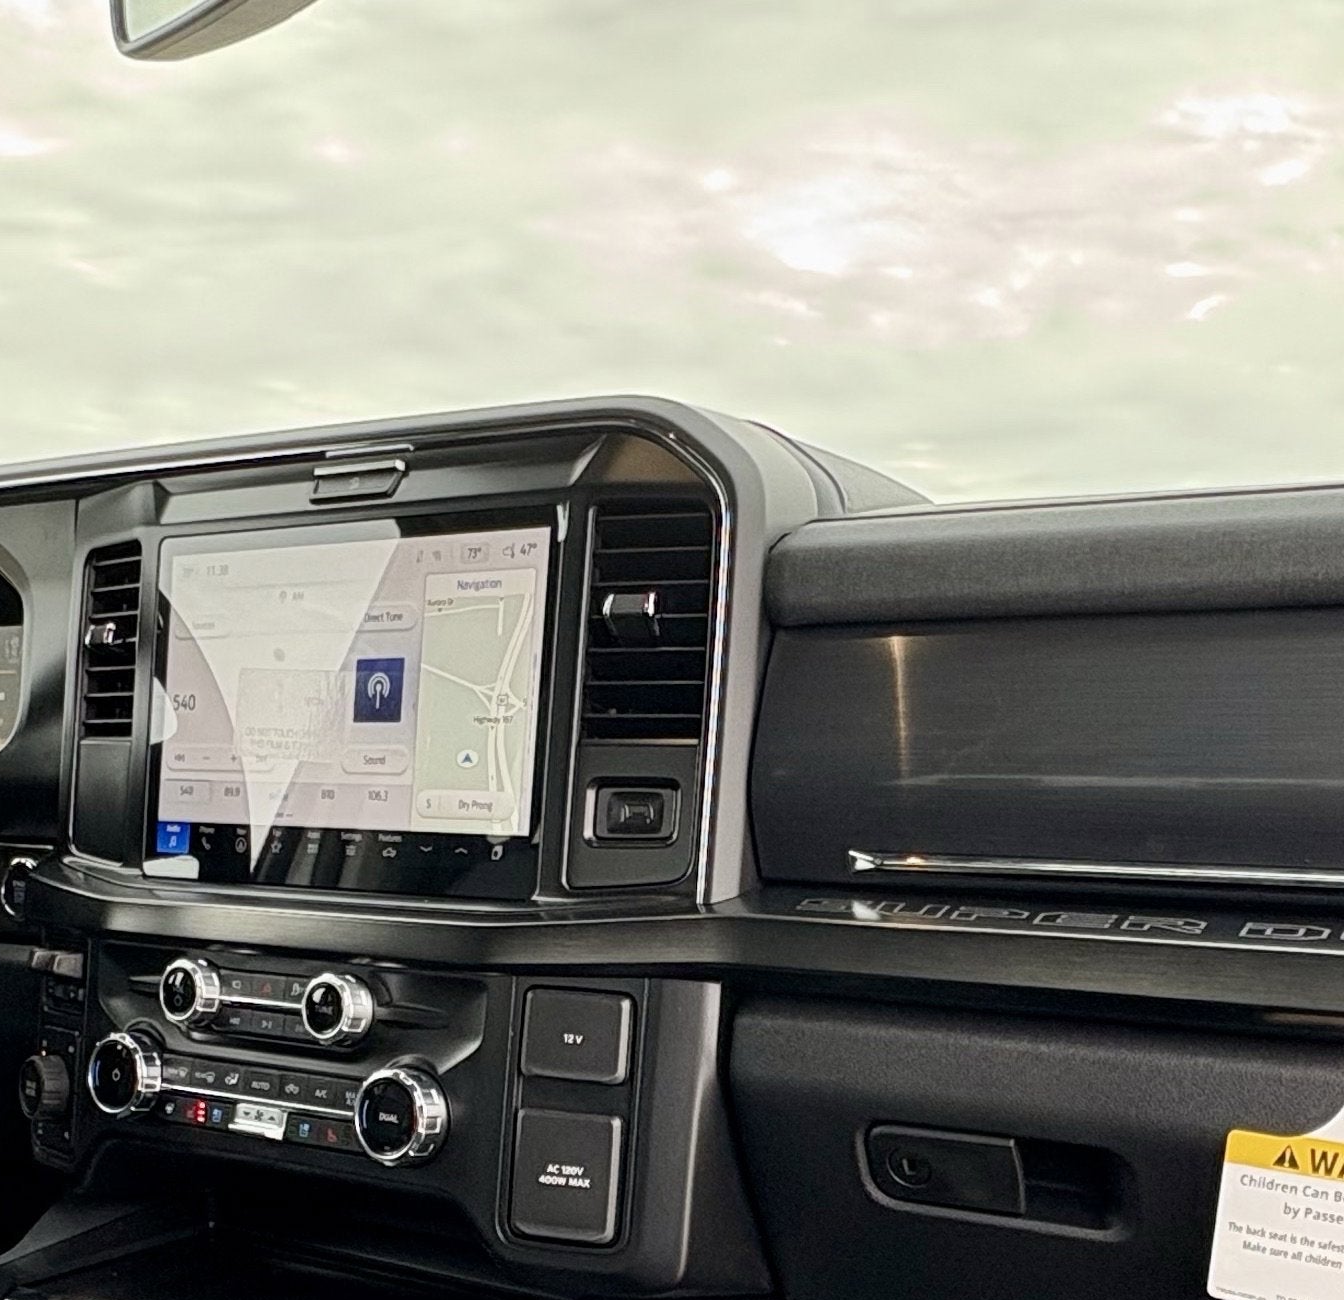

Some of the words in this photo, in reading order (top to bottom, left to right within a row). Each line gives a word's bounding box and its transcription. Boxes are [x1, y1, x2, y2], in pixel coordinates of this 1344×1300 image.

[457, 579, 502, 592] Navigation
[173, 694, 196, 711] 540
[796, 898, 1207, 935] SUPER
[564, 1033, 574, 1044] 12
[379, 1112, 399, 1124] DUAL
[547, 1164, 560, 1174] AC
[562, 1165, 584, 1176] 120V
[539, 1174, 567, 1186] 400W
[569, 1177, 591, 1188] MAX
[1240, 1174, 1298, 1195] Children
[1302, 1185, 1329, 1200] Can
[1283, 1202, 1300, 1219] by
[1228, 1221, 1243, 1233] The
[1246, 1225, 1266, 1238] back
[1268, 1231, 1287, 1241] seat
[1290, 1233, 1297, 1244] is
[1300, 1236, 1315, 1247] the
[1318, 1240, 1344, 1253] safest
[1242, 1240, 1267, 1254] Make
[1269, 1247, 1288, 1259] sure
[1291, 1251, 1303, 1262] all
[1305, 1254, 1342, 1270] children
